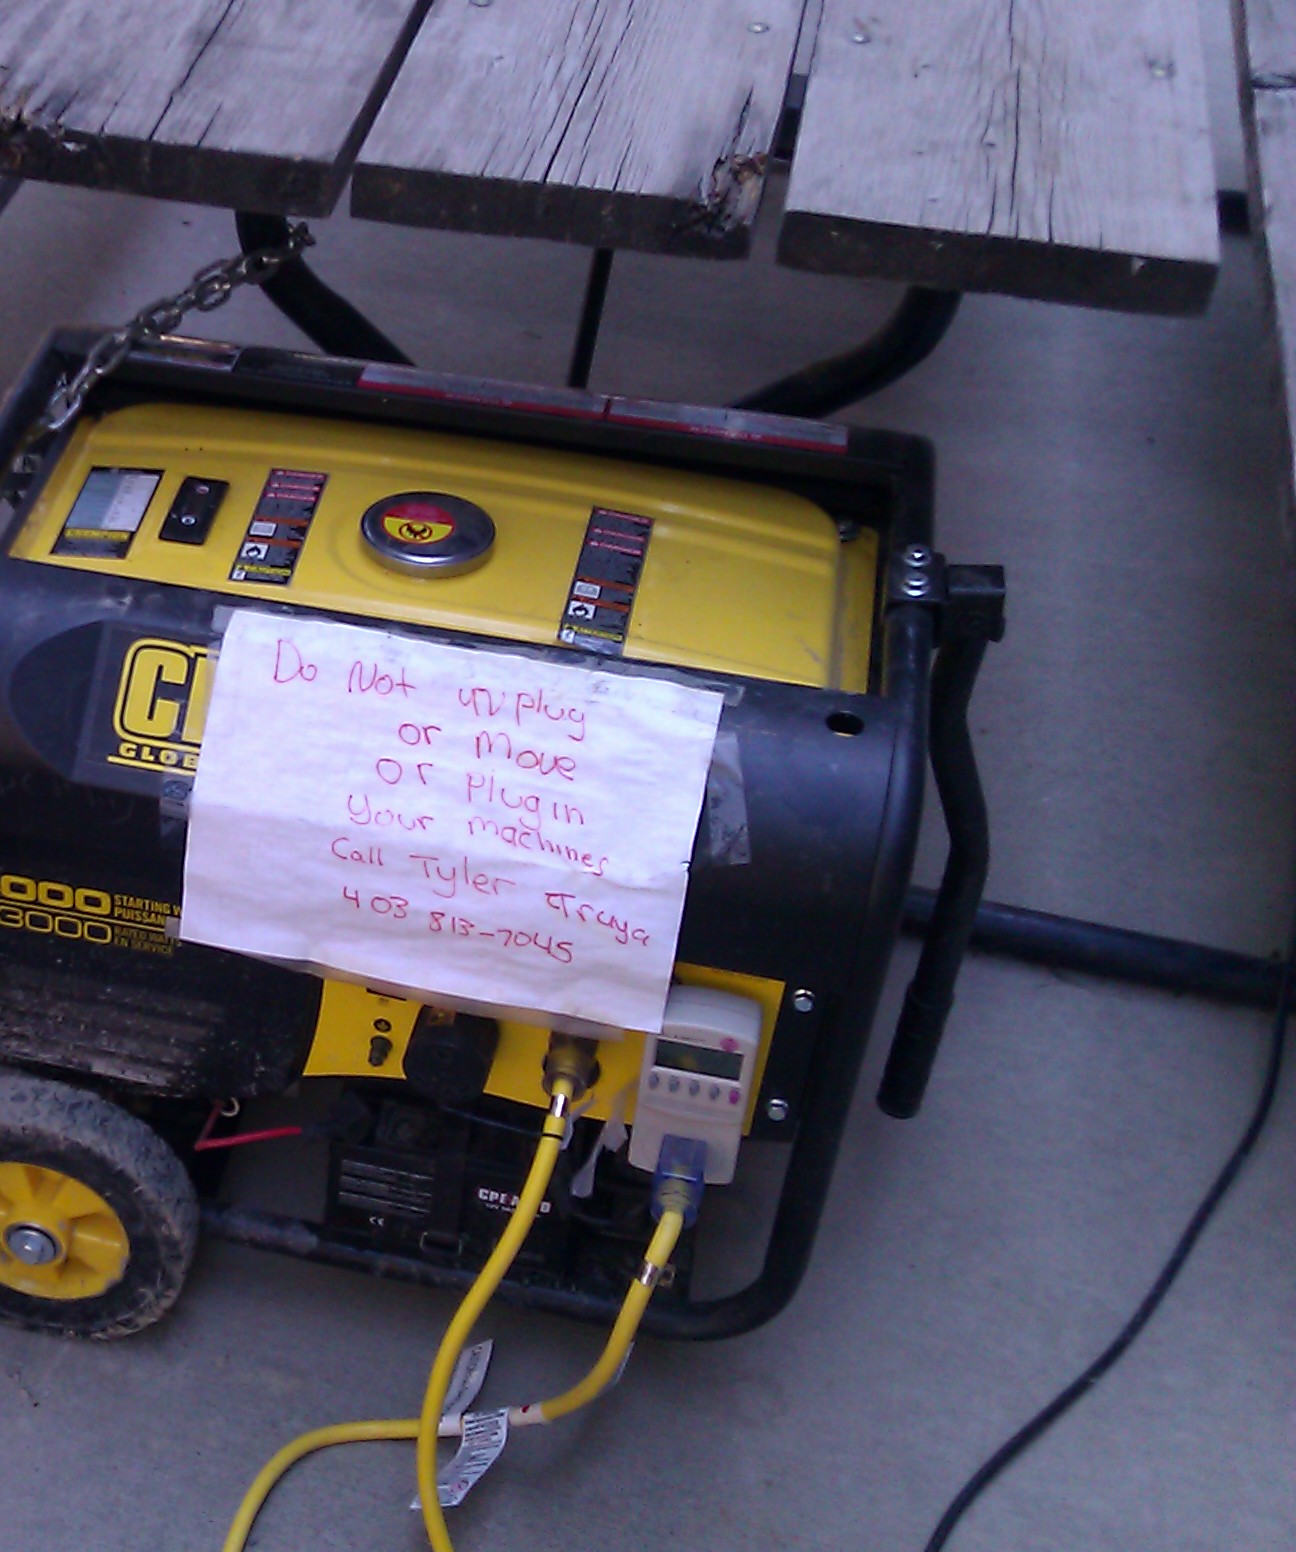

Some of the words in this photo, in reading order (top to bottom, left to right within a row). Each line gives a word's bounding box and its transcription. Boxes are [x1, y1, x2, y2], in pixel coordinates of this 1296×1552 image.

[273, 638, 318, 684] Do
[348, 660, 417, 698] Not
[330, 836, 384, 867] Call
[409, 854, 517, 898] Tyler
[114, 893, 171, 914] STARTING
[342, 885, 410, 920] 403
[428, 911, 574, 964] 813-7045
